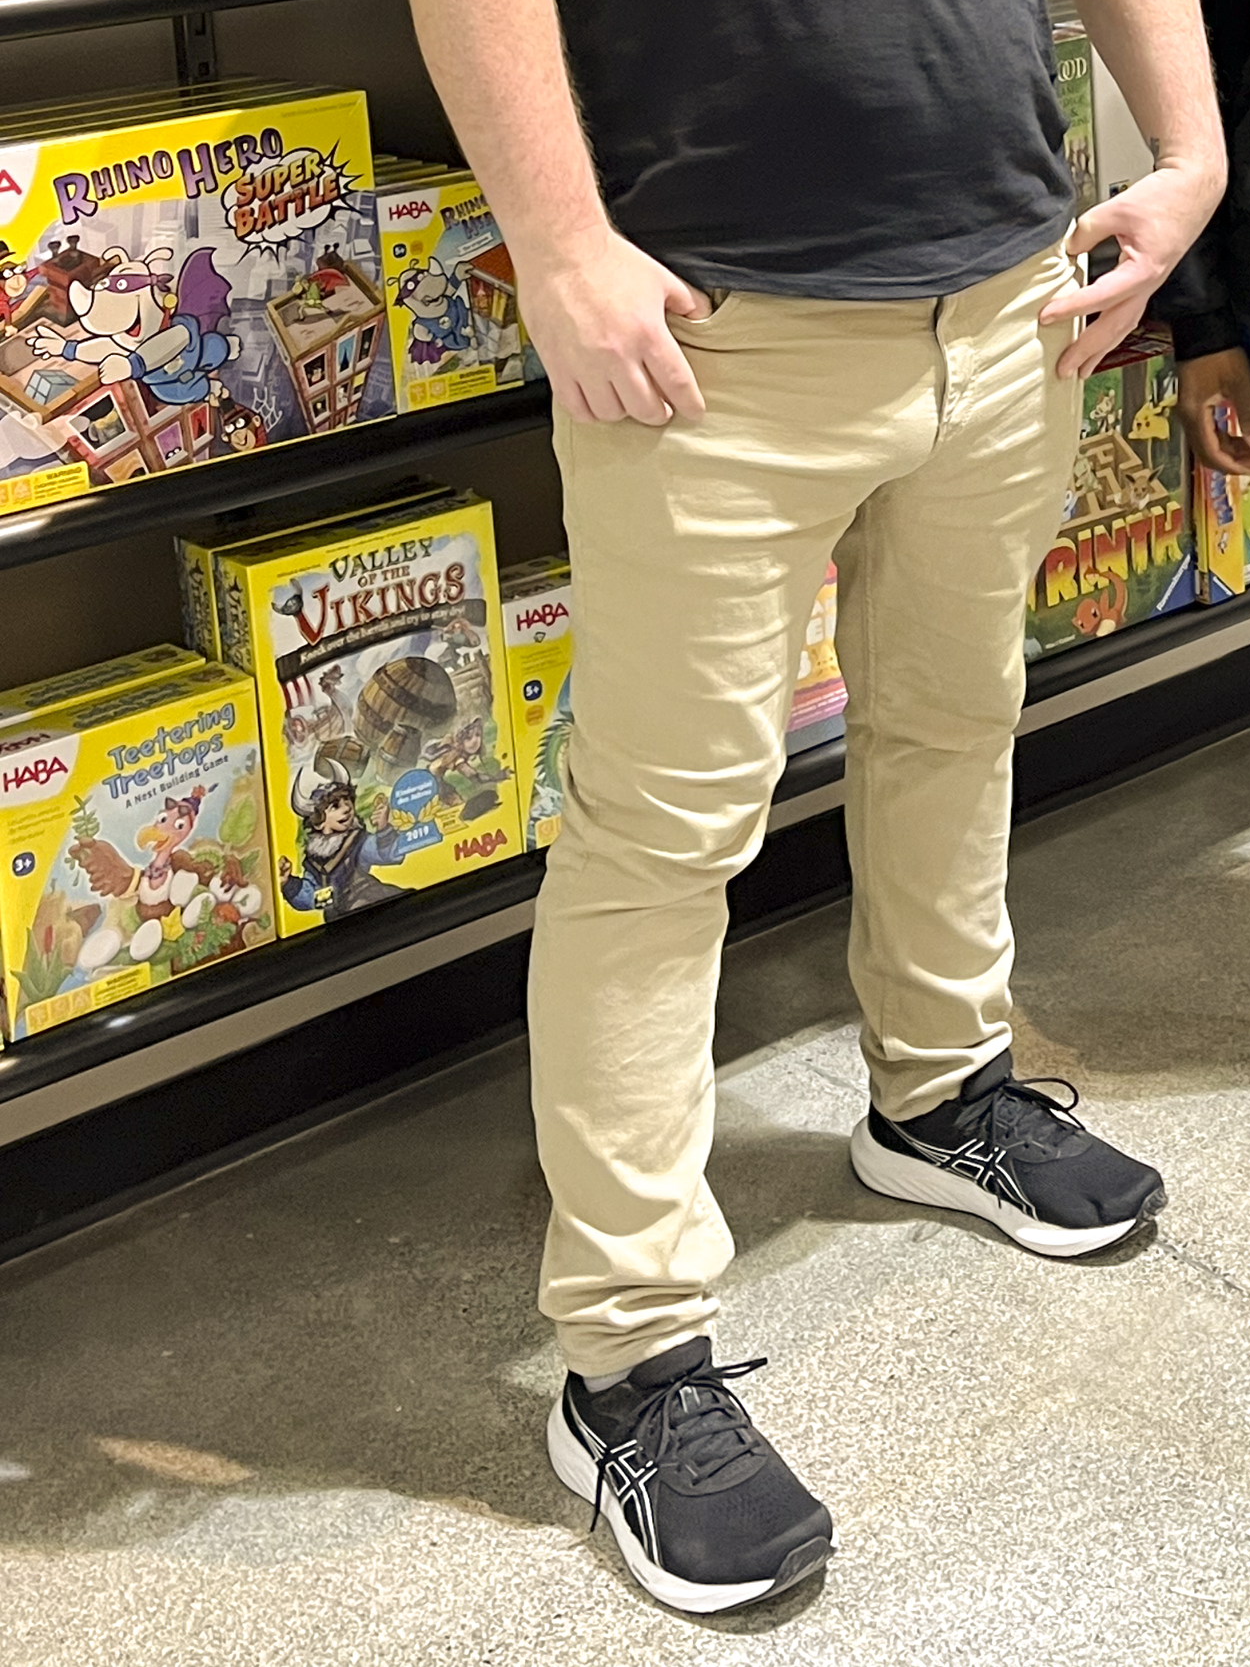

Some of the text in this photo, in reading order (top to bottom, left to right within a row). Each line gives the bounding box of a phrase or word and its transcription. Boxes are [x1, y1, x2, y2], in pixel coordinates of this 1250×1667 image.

[53, 127, 283, 225] RHINO HERO
[235, 151, 324, 206] SUPER
[233, 171, 341, 236] BATTLE
[388, 200, 433, 221] HABA
[328, 536, 433, 582] VALLEY
[357, 564, 411, 589] OF THE
[296, 561, 466, 646] VIKINGS
[516, 601, 569, 632] HABA
[107, 702, 236, 771] Teetering
[2, 756, 69, 793] HABA
[102, 734, 224, 800] Treetops
[125, 754, 230, 809] A Nest Building Game
[405, 825, 430, 842] 2019
[453, 828, 508, 862] HABA
[14, 858, 33, 873] 3+
